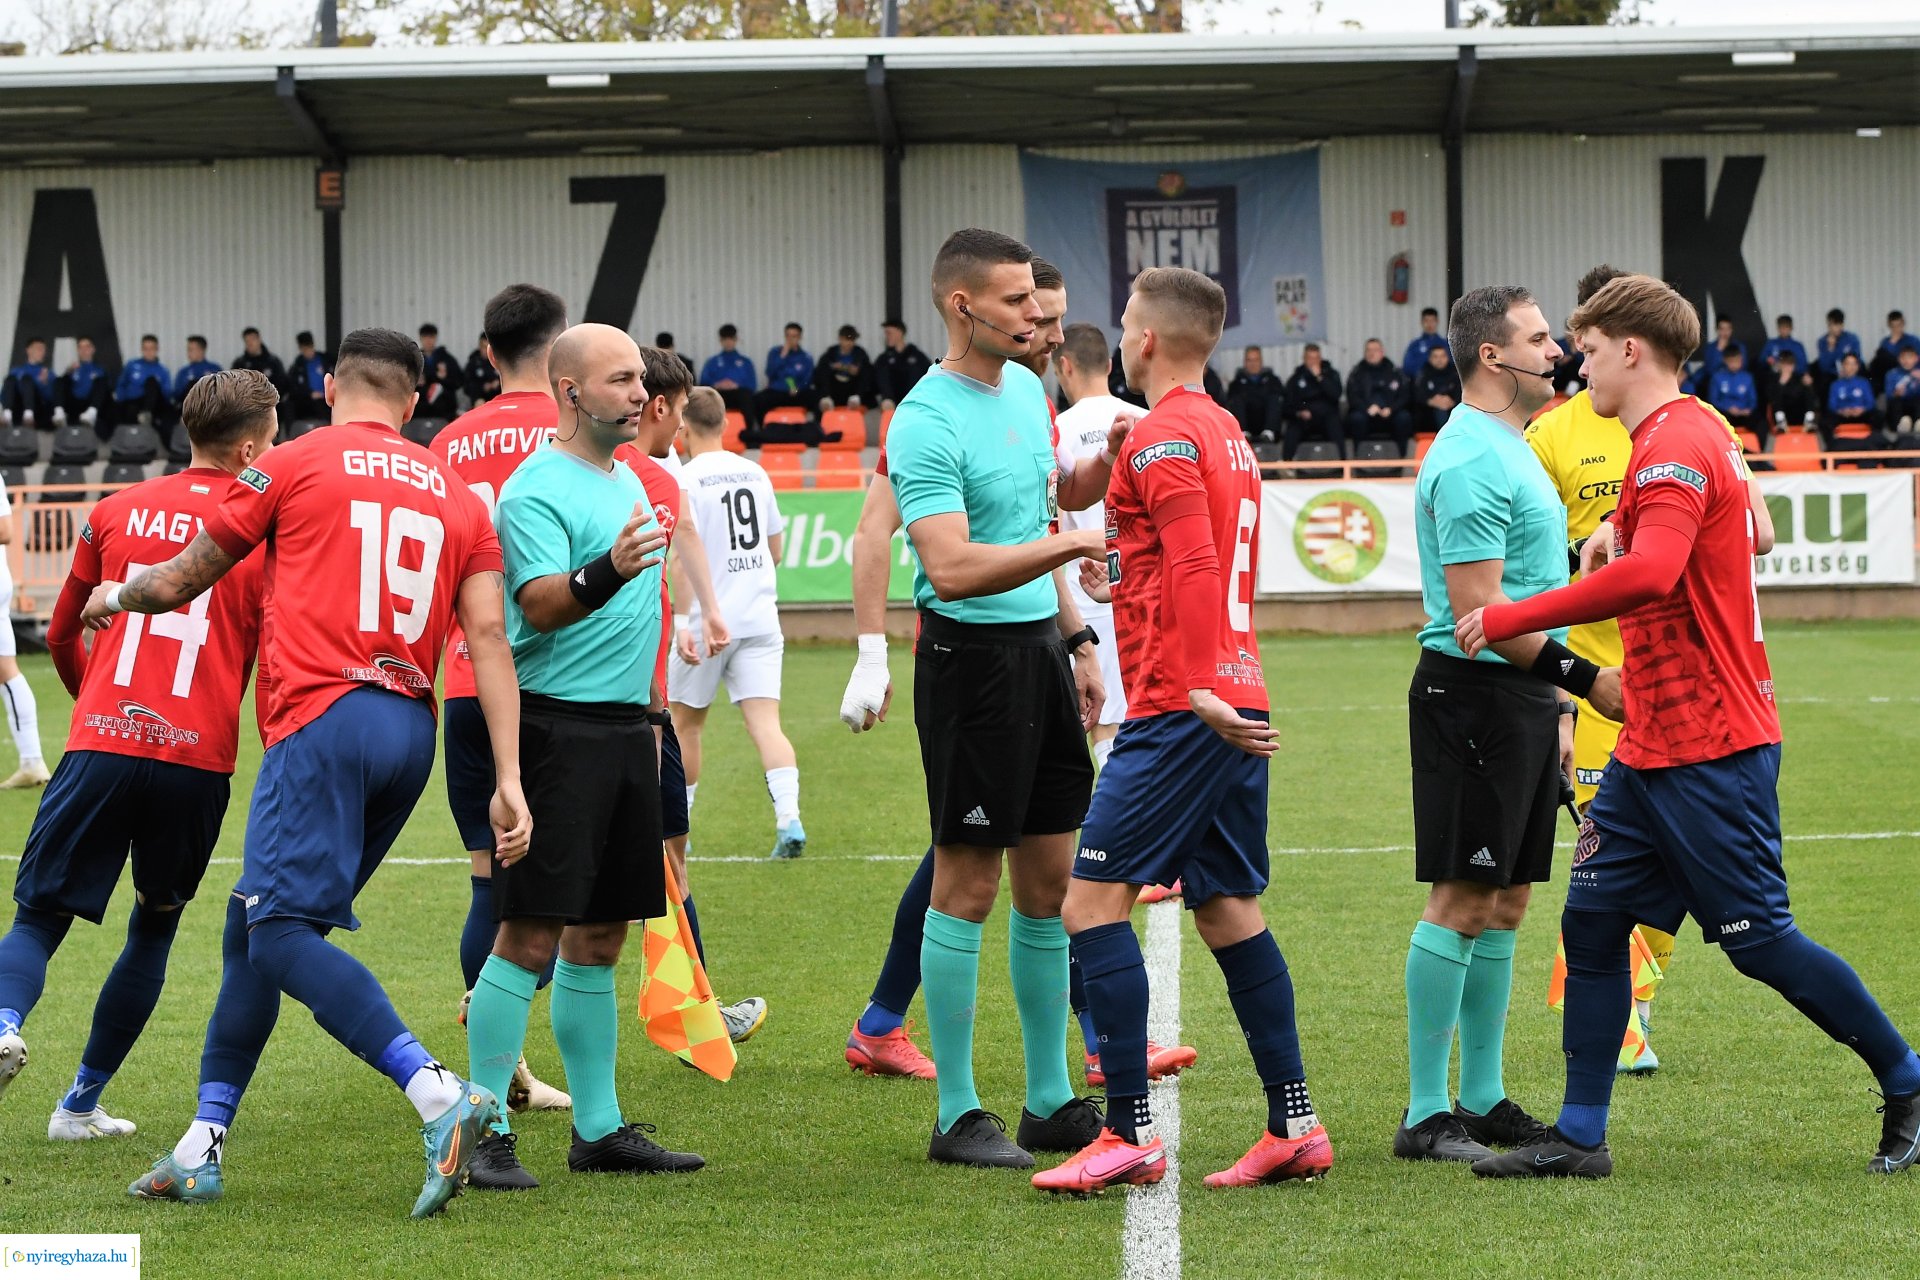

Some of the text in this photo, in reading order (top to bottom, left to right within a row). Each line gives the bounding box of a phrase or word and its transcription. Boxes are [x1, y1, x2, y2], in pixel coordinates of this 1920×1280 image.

[1126, 228, 1220, 275] NEM
[1661, 156, 1768, 361] K
[7, 188, 124, 378] A
[342, 450, 446, 498] GRESÓ
[1580, 455, 1606, 466] JAKO
[720, 487, 760, 551] 19
[349, 499, 445, 644] 19
[727, 555, 763, 573] SZALKA
[113, 562, 211, 698] 14
[85, 713, 199, 745] LERTON TRANS
[963, 816, 990, 826] adidas
[1080, 847, 1107, 862] JAKO
[1469, 857, 1496, 867] adidas
[1720, 919, 1751, 935] JAKO
